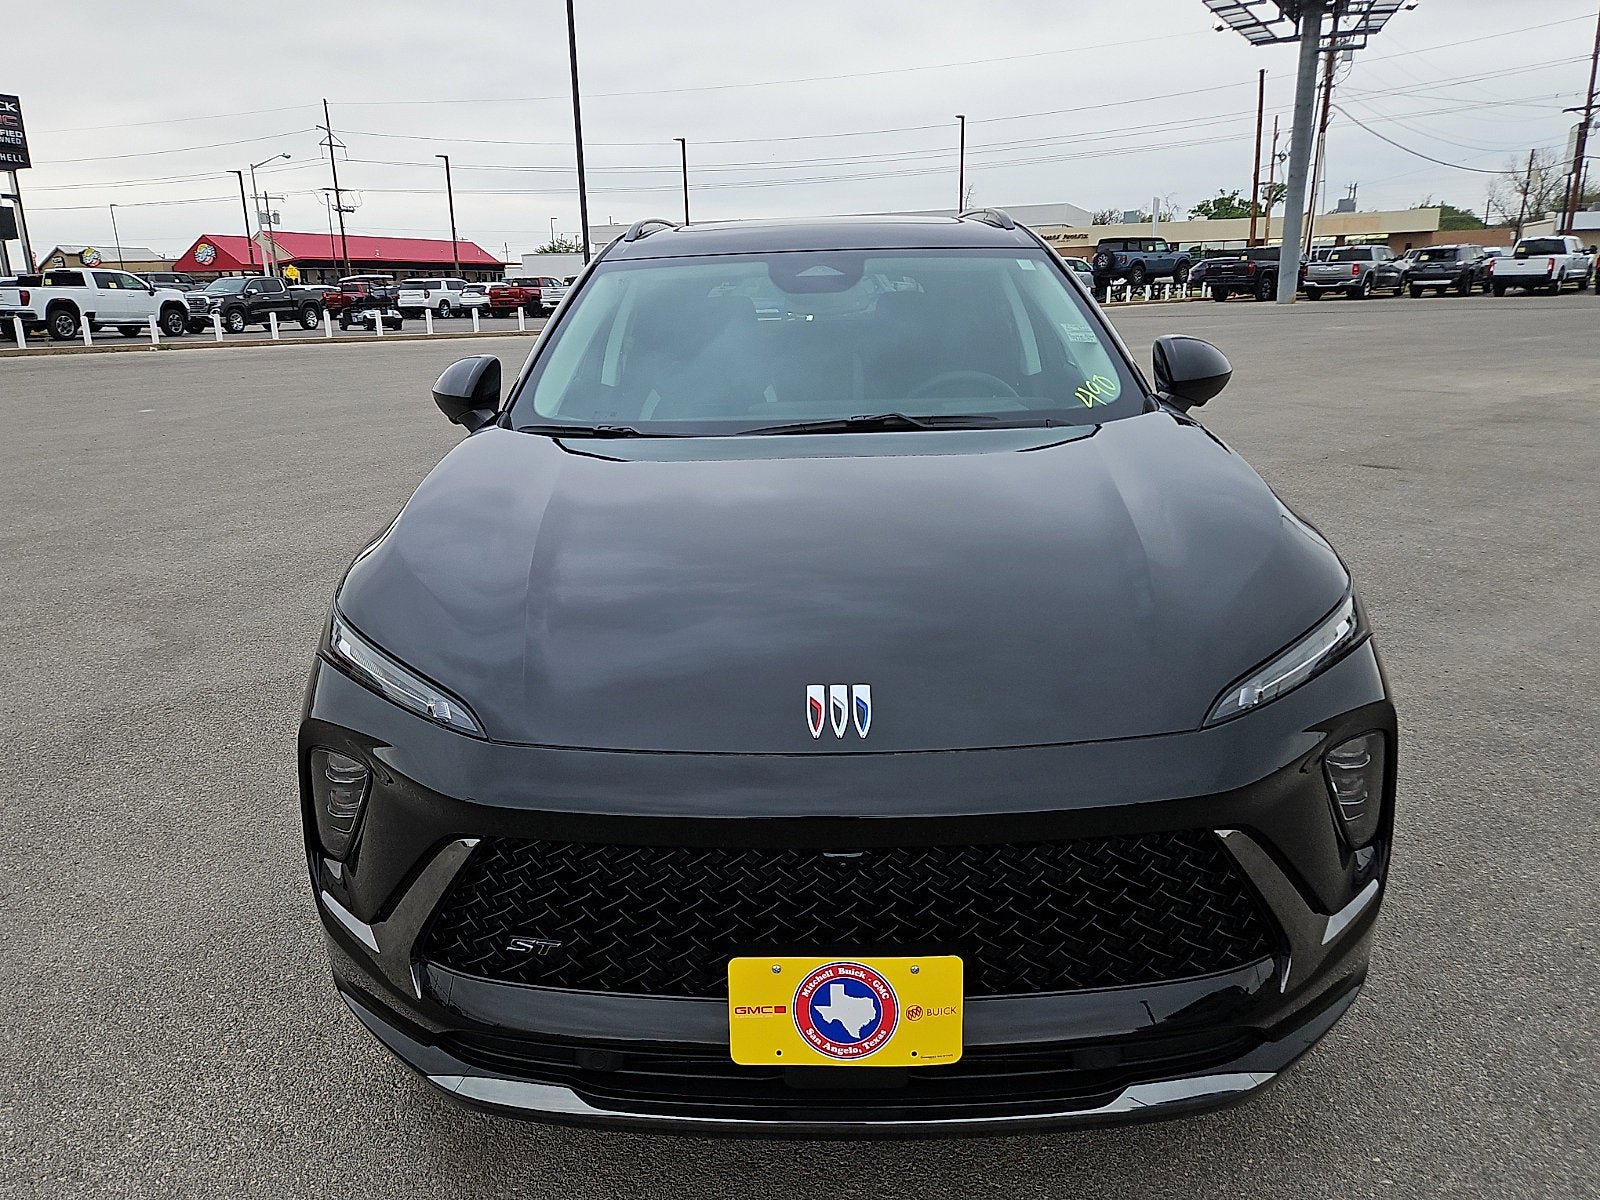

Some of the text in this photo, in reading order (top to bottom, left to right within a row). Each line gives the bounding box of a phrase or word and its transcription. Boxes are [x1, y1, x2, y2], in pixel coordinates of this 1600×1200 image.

[506, 938, 561, 955] ST
[801, 969, 834, 998] Mitchell
[838, 967, 866, 979] Buick
[872, 979, 890, 1000] GMC
[734, 1006, 772, 1015] GMC
[926, 1006, 957, 1017] BUICK
[805, 1027, 887, 1055] San Angelo, Texas
